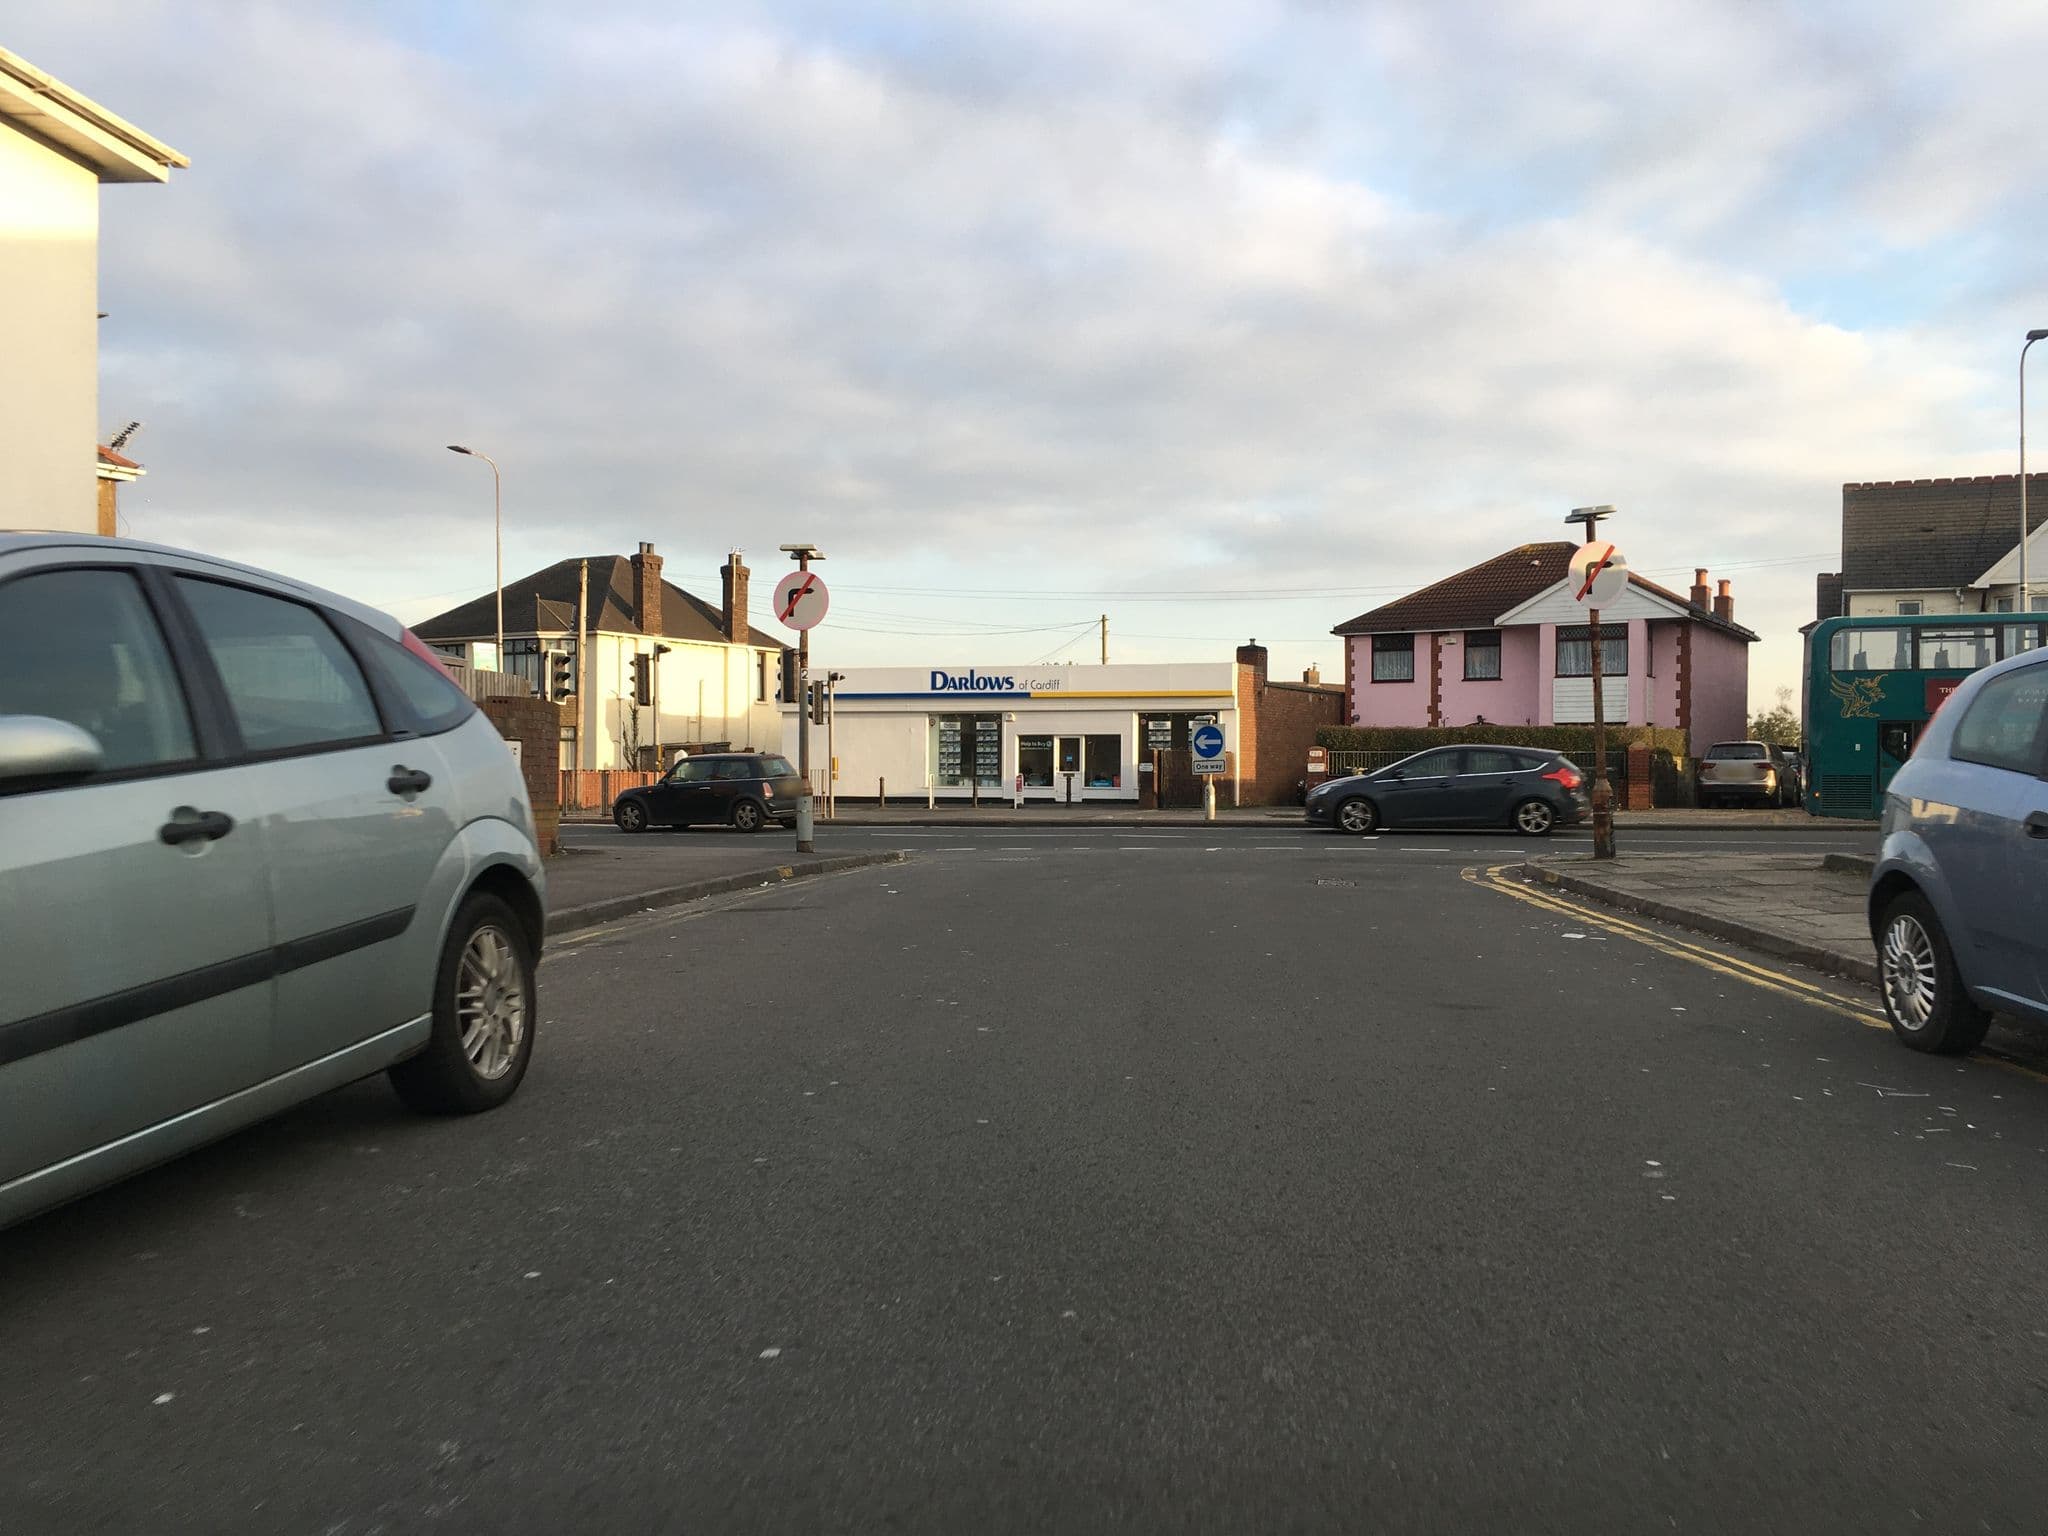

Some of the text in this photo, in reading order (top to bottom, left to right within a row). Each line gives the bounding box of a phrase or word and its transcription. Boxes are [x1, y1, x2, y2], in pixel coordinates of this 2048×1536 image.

[801, 669, 809, 680] 2
[1018, 681, 1028, 690] of
[1030, 680, 1060, 690] Cardiff
